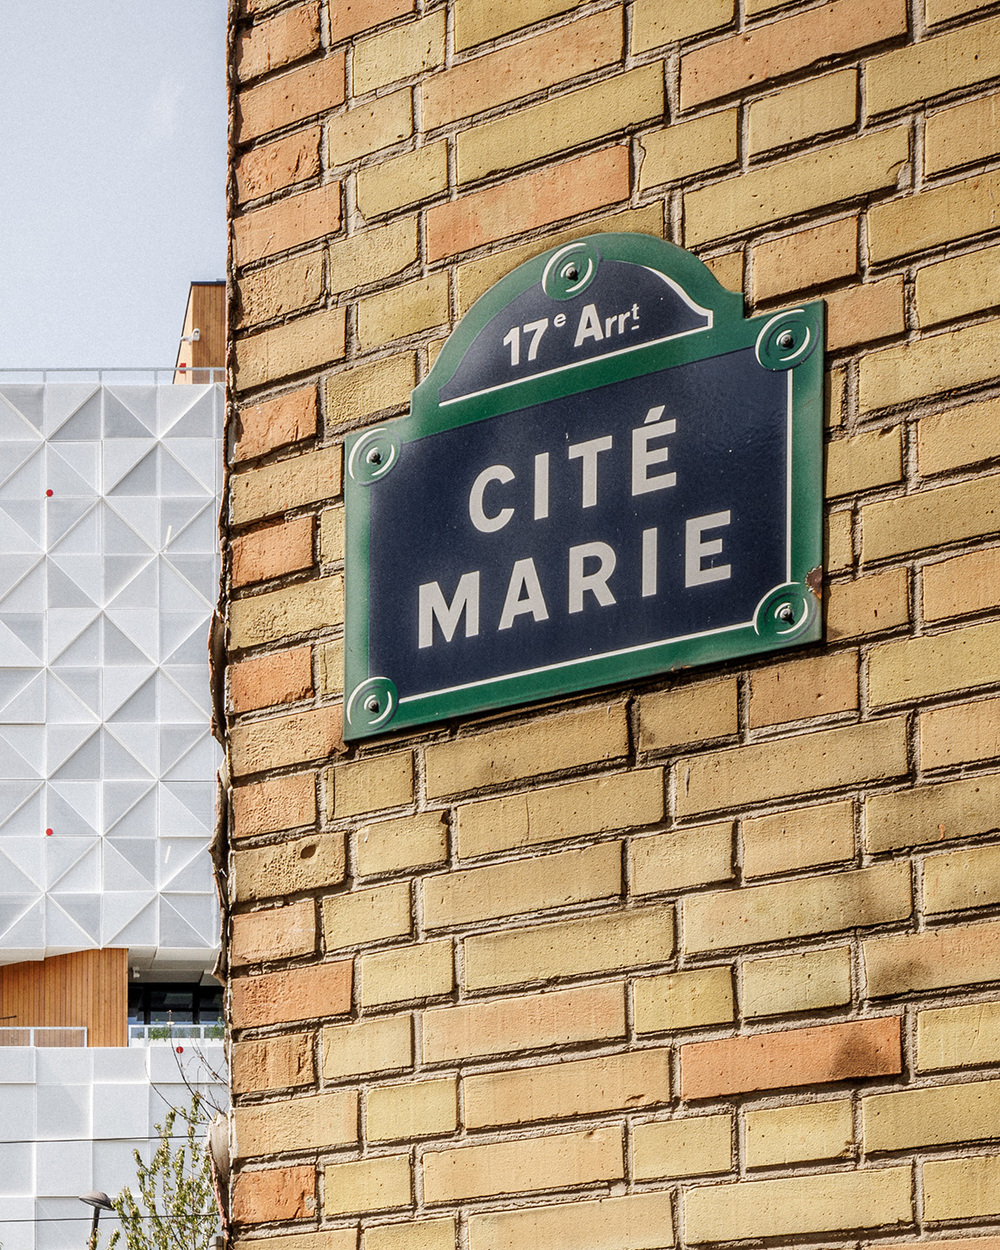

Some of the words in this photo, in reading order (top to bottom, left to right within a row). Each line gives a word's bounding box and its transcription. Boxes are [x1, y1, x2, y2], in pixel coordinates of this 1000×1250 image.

[503, 311, 567, 367] 17e
[468, 404, 677, 534] CITÉ
[418, 509, 732, 650] MARIE
